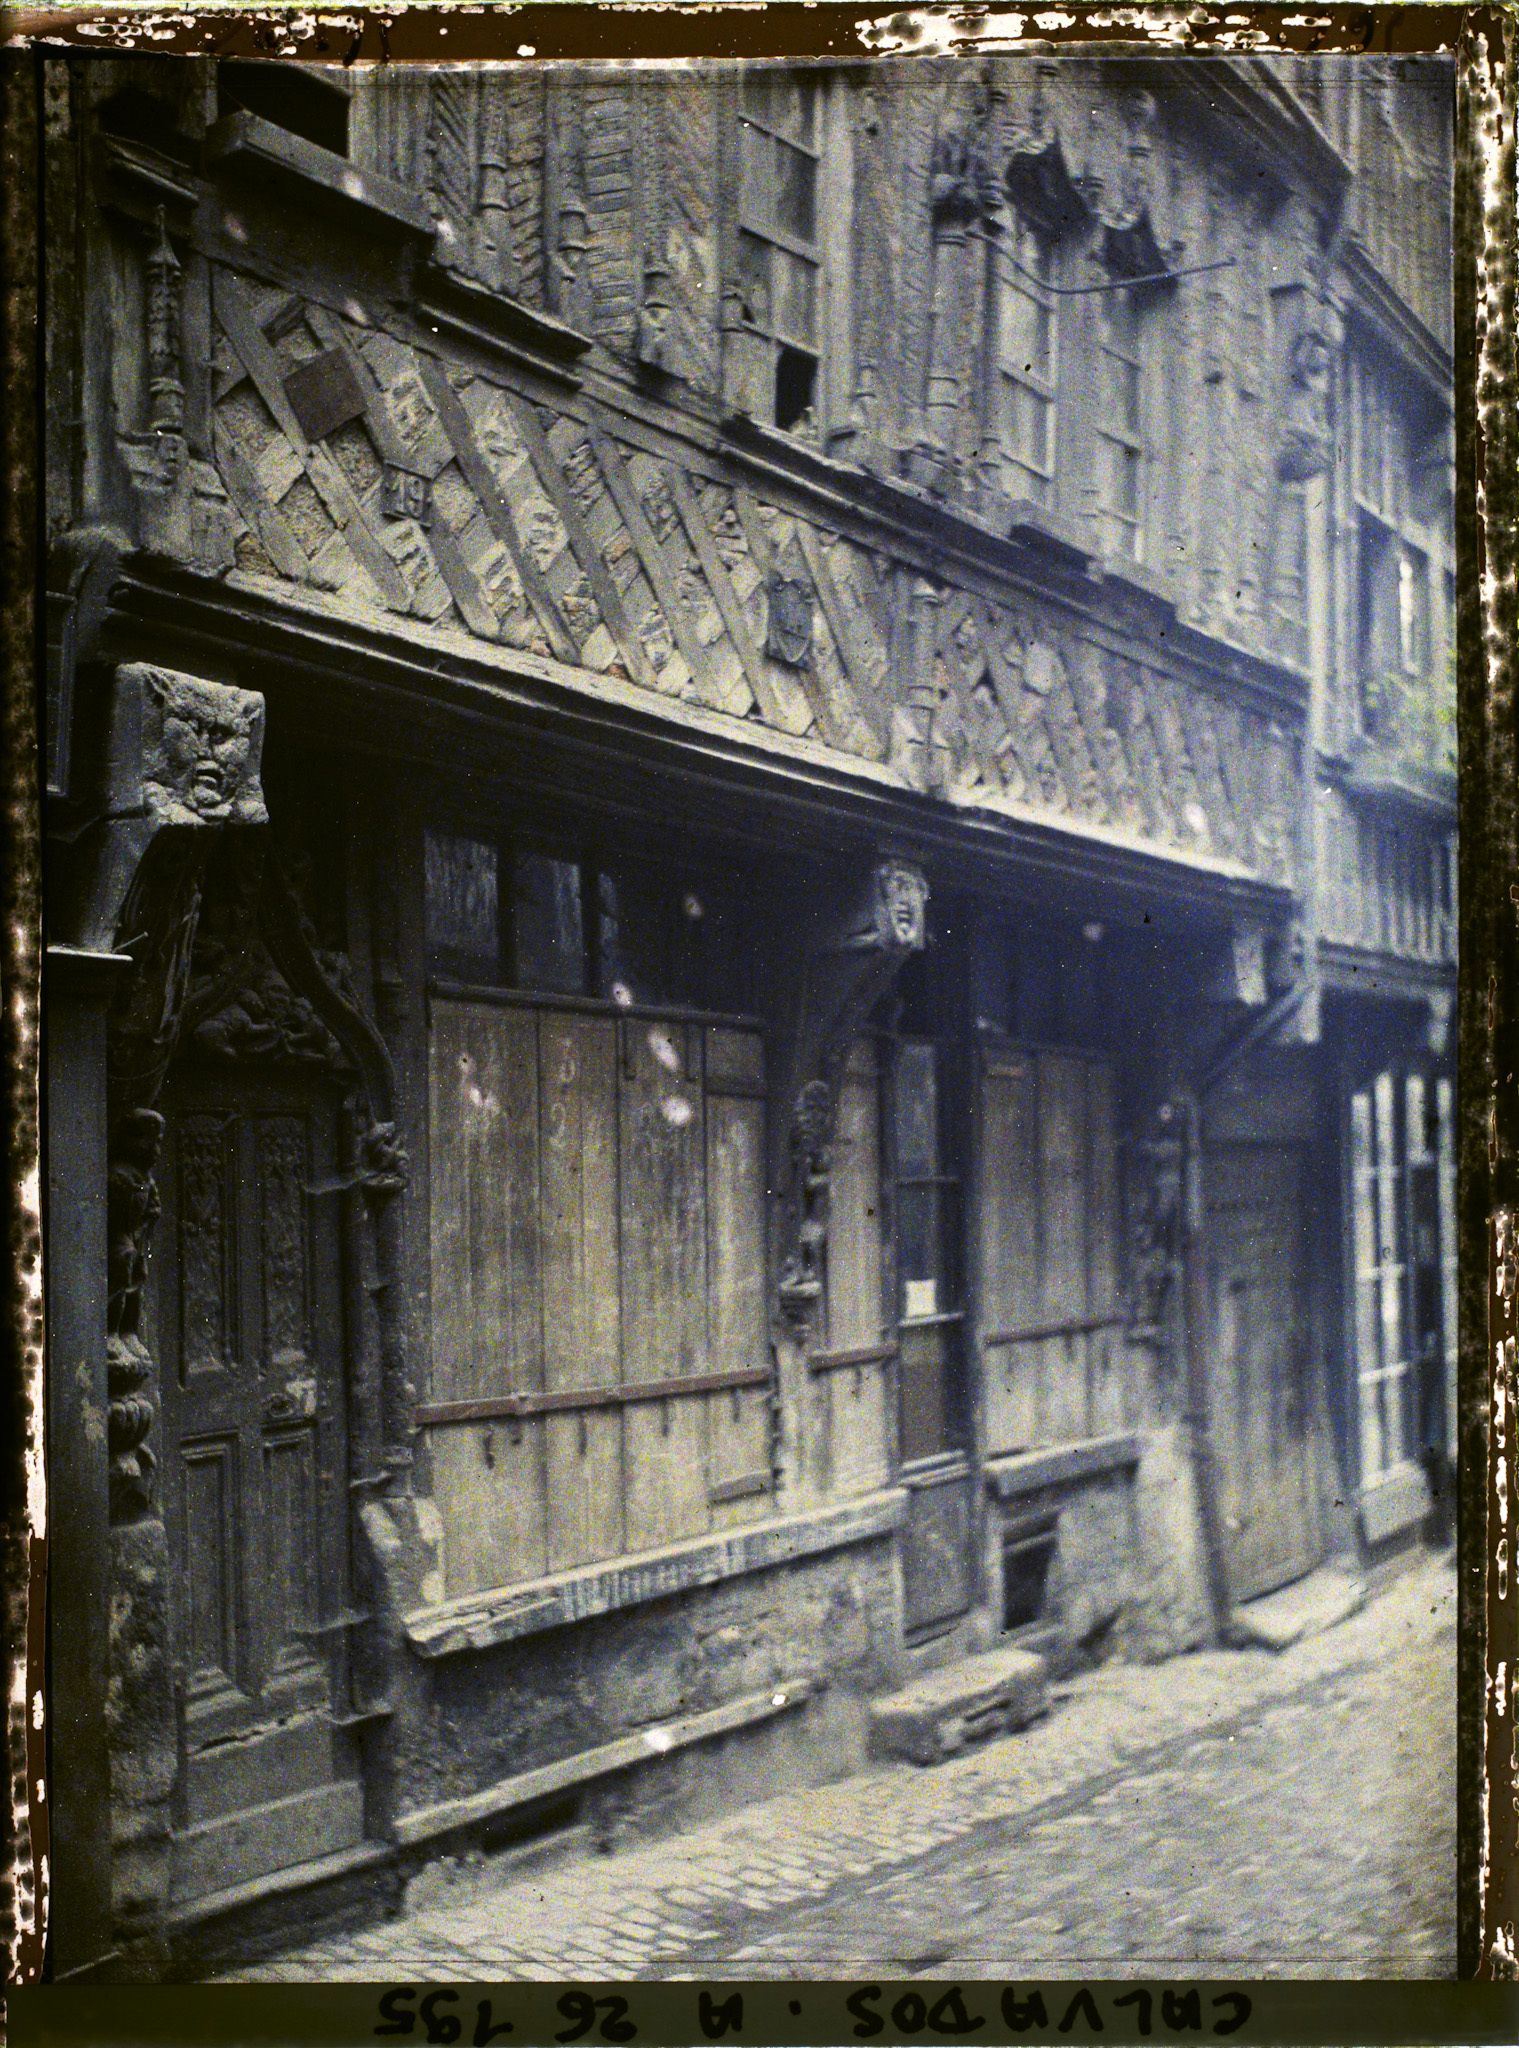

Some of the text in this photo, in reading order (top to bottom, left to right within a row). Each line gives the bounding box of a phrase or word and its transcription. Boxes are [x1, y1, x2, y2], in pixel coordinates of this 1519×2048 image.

[373, 1985, 1253, 2047] CALVADOS A 26 195
